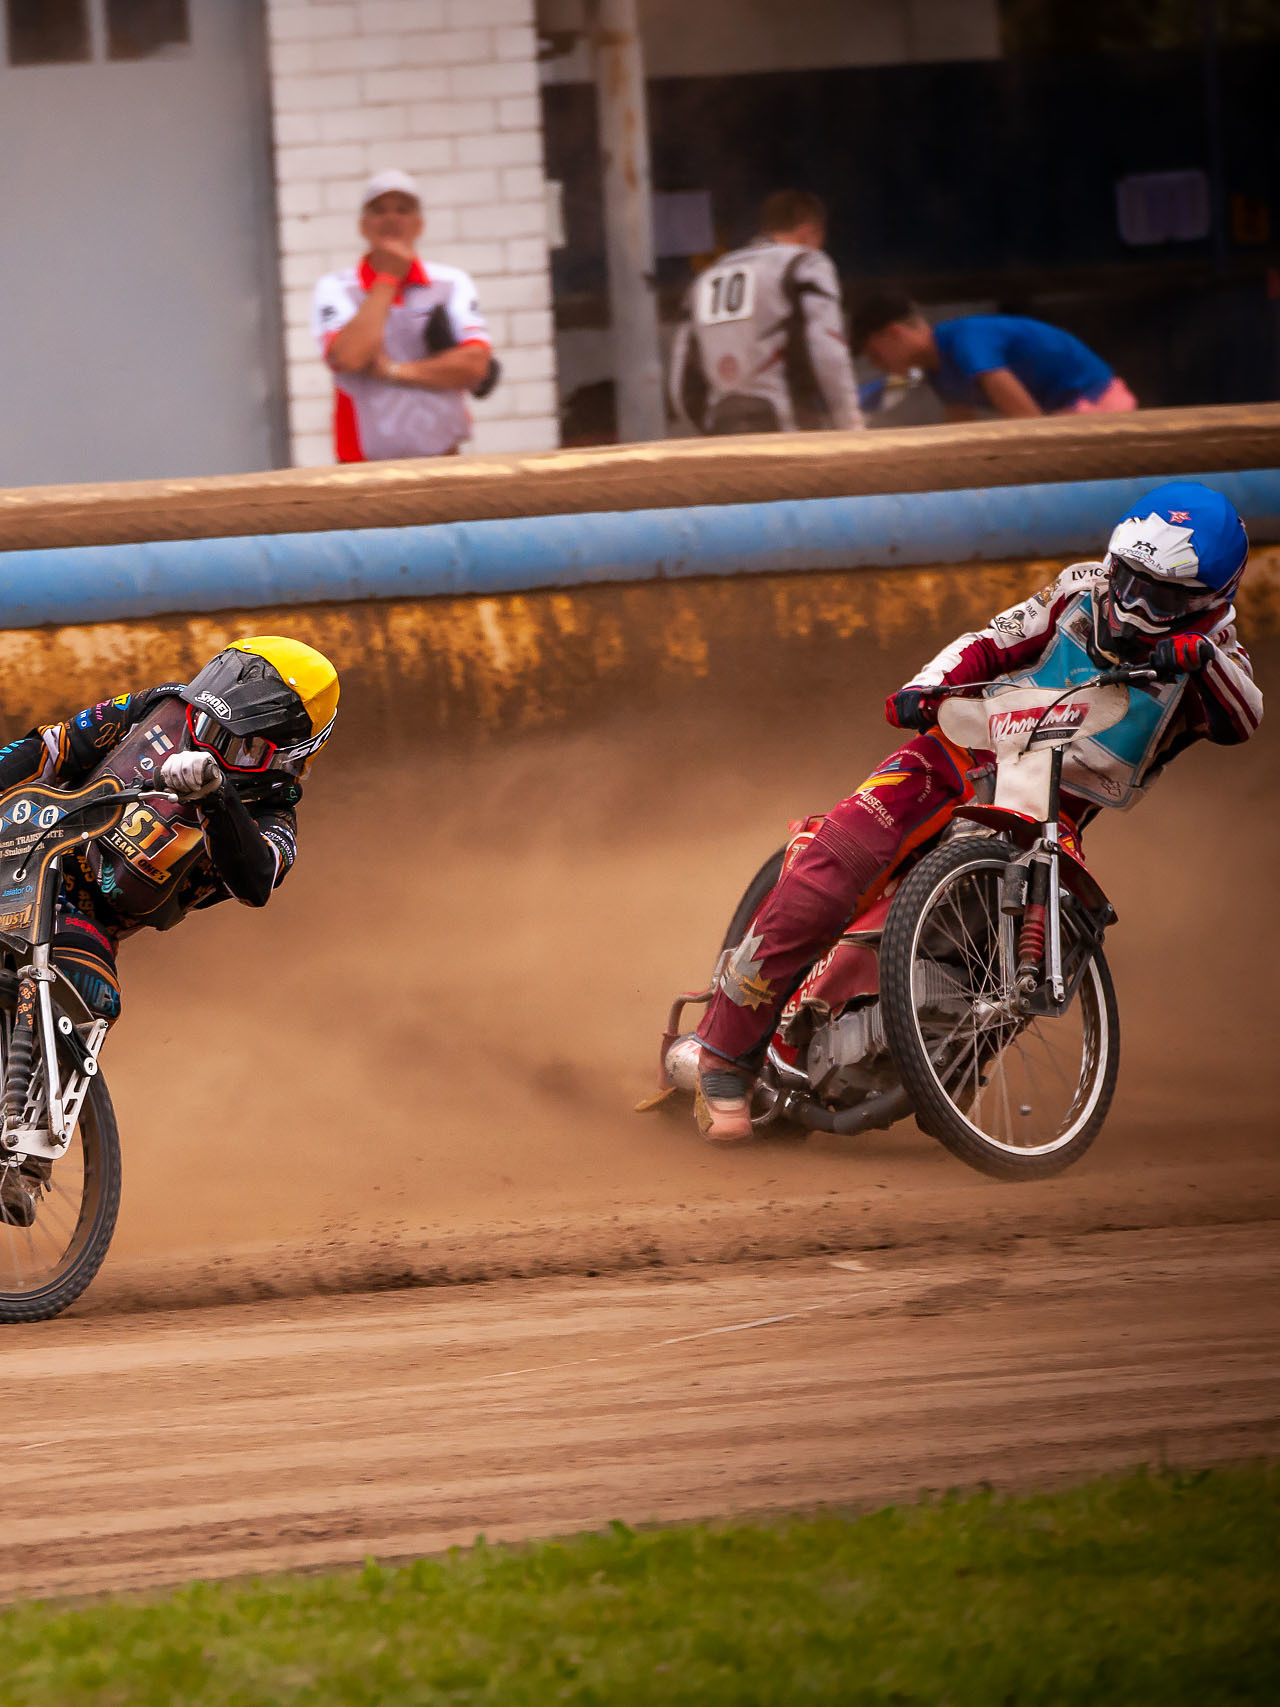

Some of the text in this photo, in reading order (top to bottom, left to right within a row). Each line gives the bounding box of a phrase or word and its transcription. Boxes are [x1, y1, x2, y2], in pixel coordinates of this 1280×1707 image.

[712, 273, 745, 315] 10
[197, 690, 230, 716] SHOEI
[850, 786, 895, 827] AUSEKLIS
[111, 832, 137, 857] TEAM
